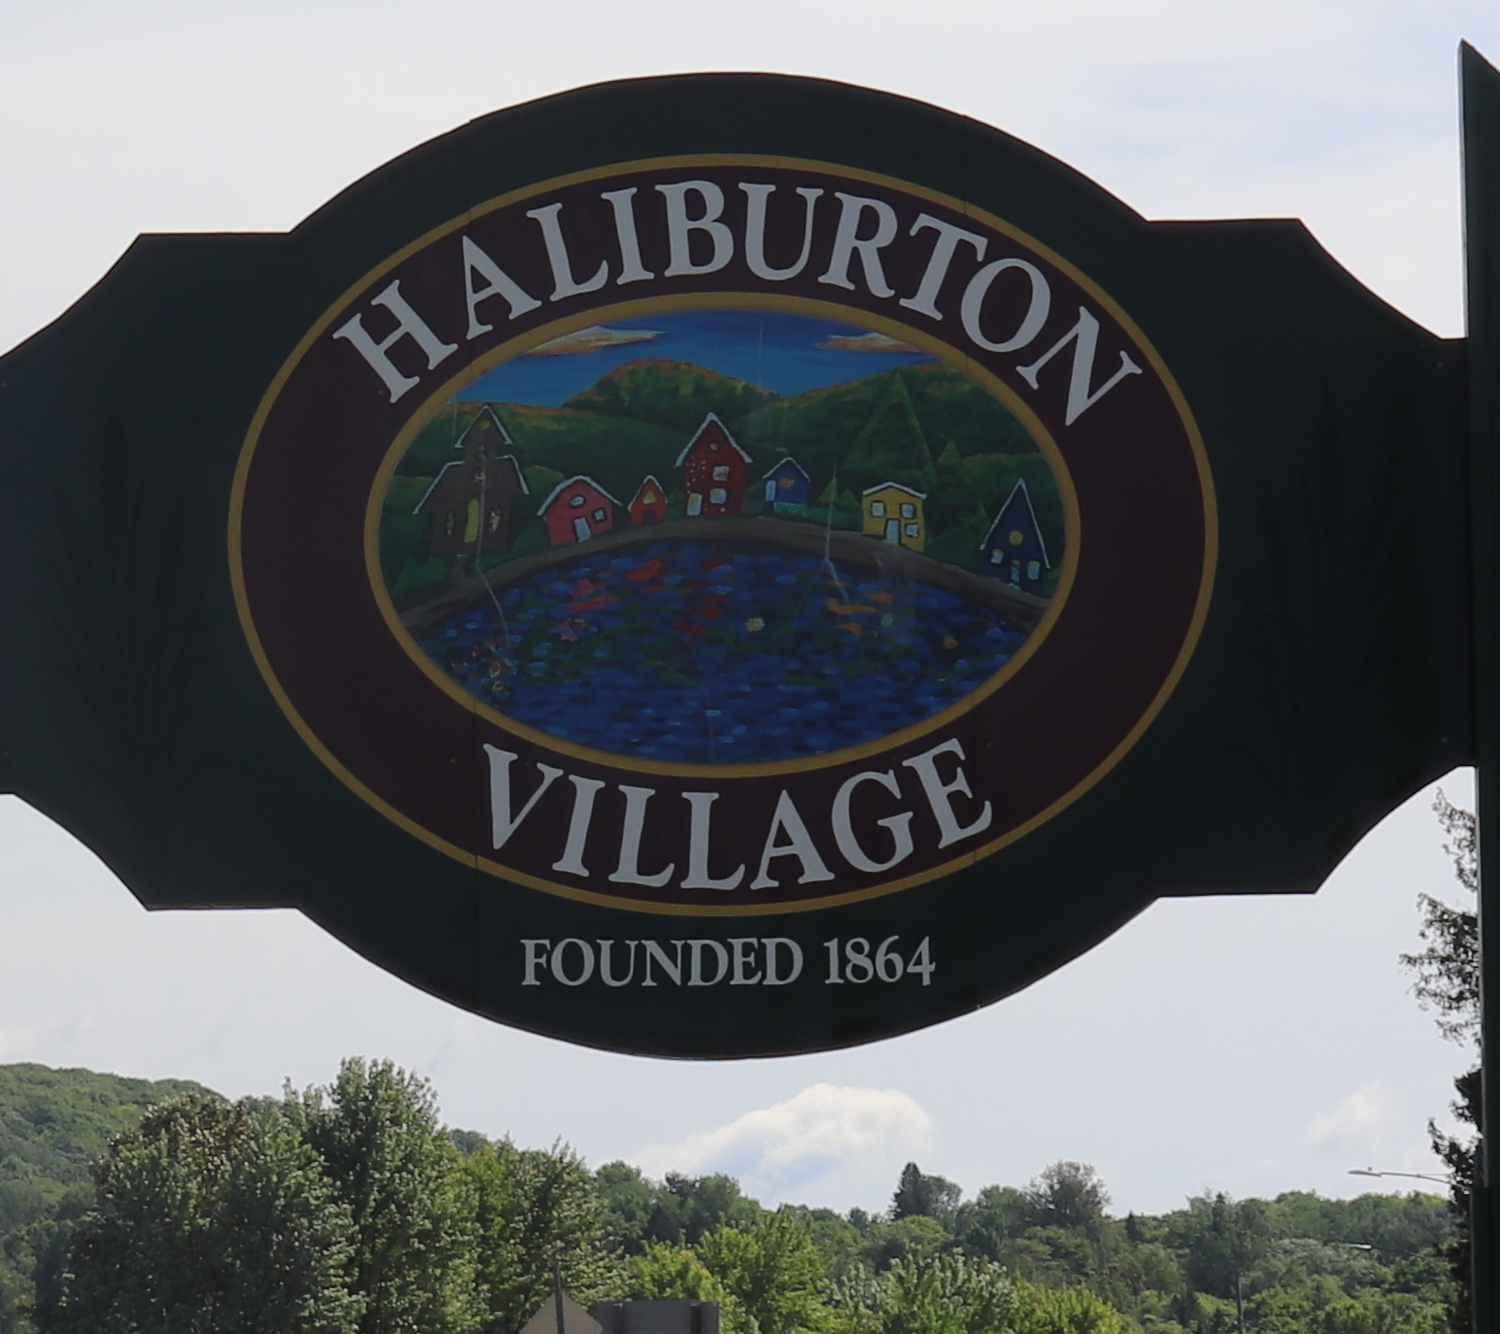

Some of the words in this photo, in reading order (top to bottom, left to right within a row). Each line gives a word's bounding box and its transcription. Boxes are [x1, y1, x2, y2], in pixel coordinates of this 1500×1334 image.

[333, 179, 1143, 427] HALIBURTON
[483, 737, 992, 890] VILLAGE
[520, 937, 803, 987] FOUNDED
[823, 935, 936, 986] 1864
